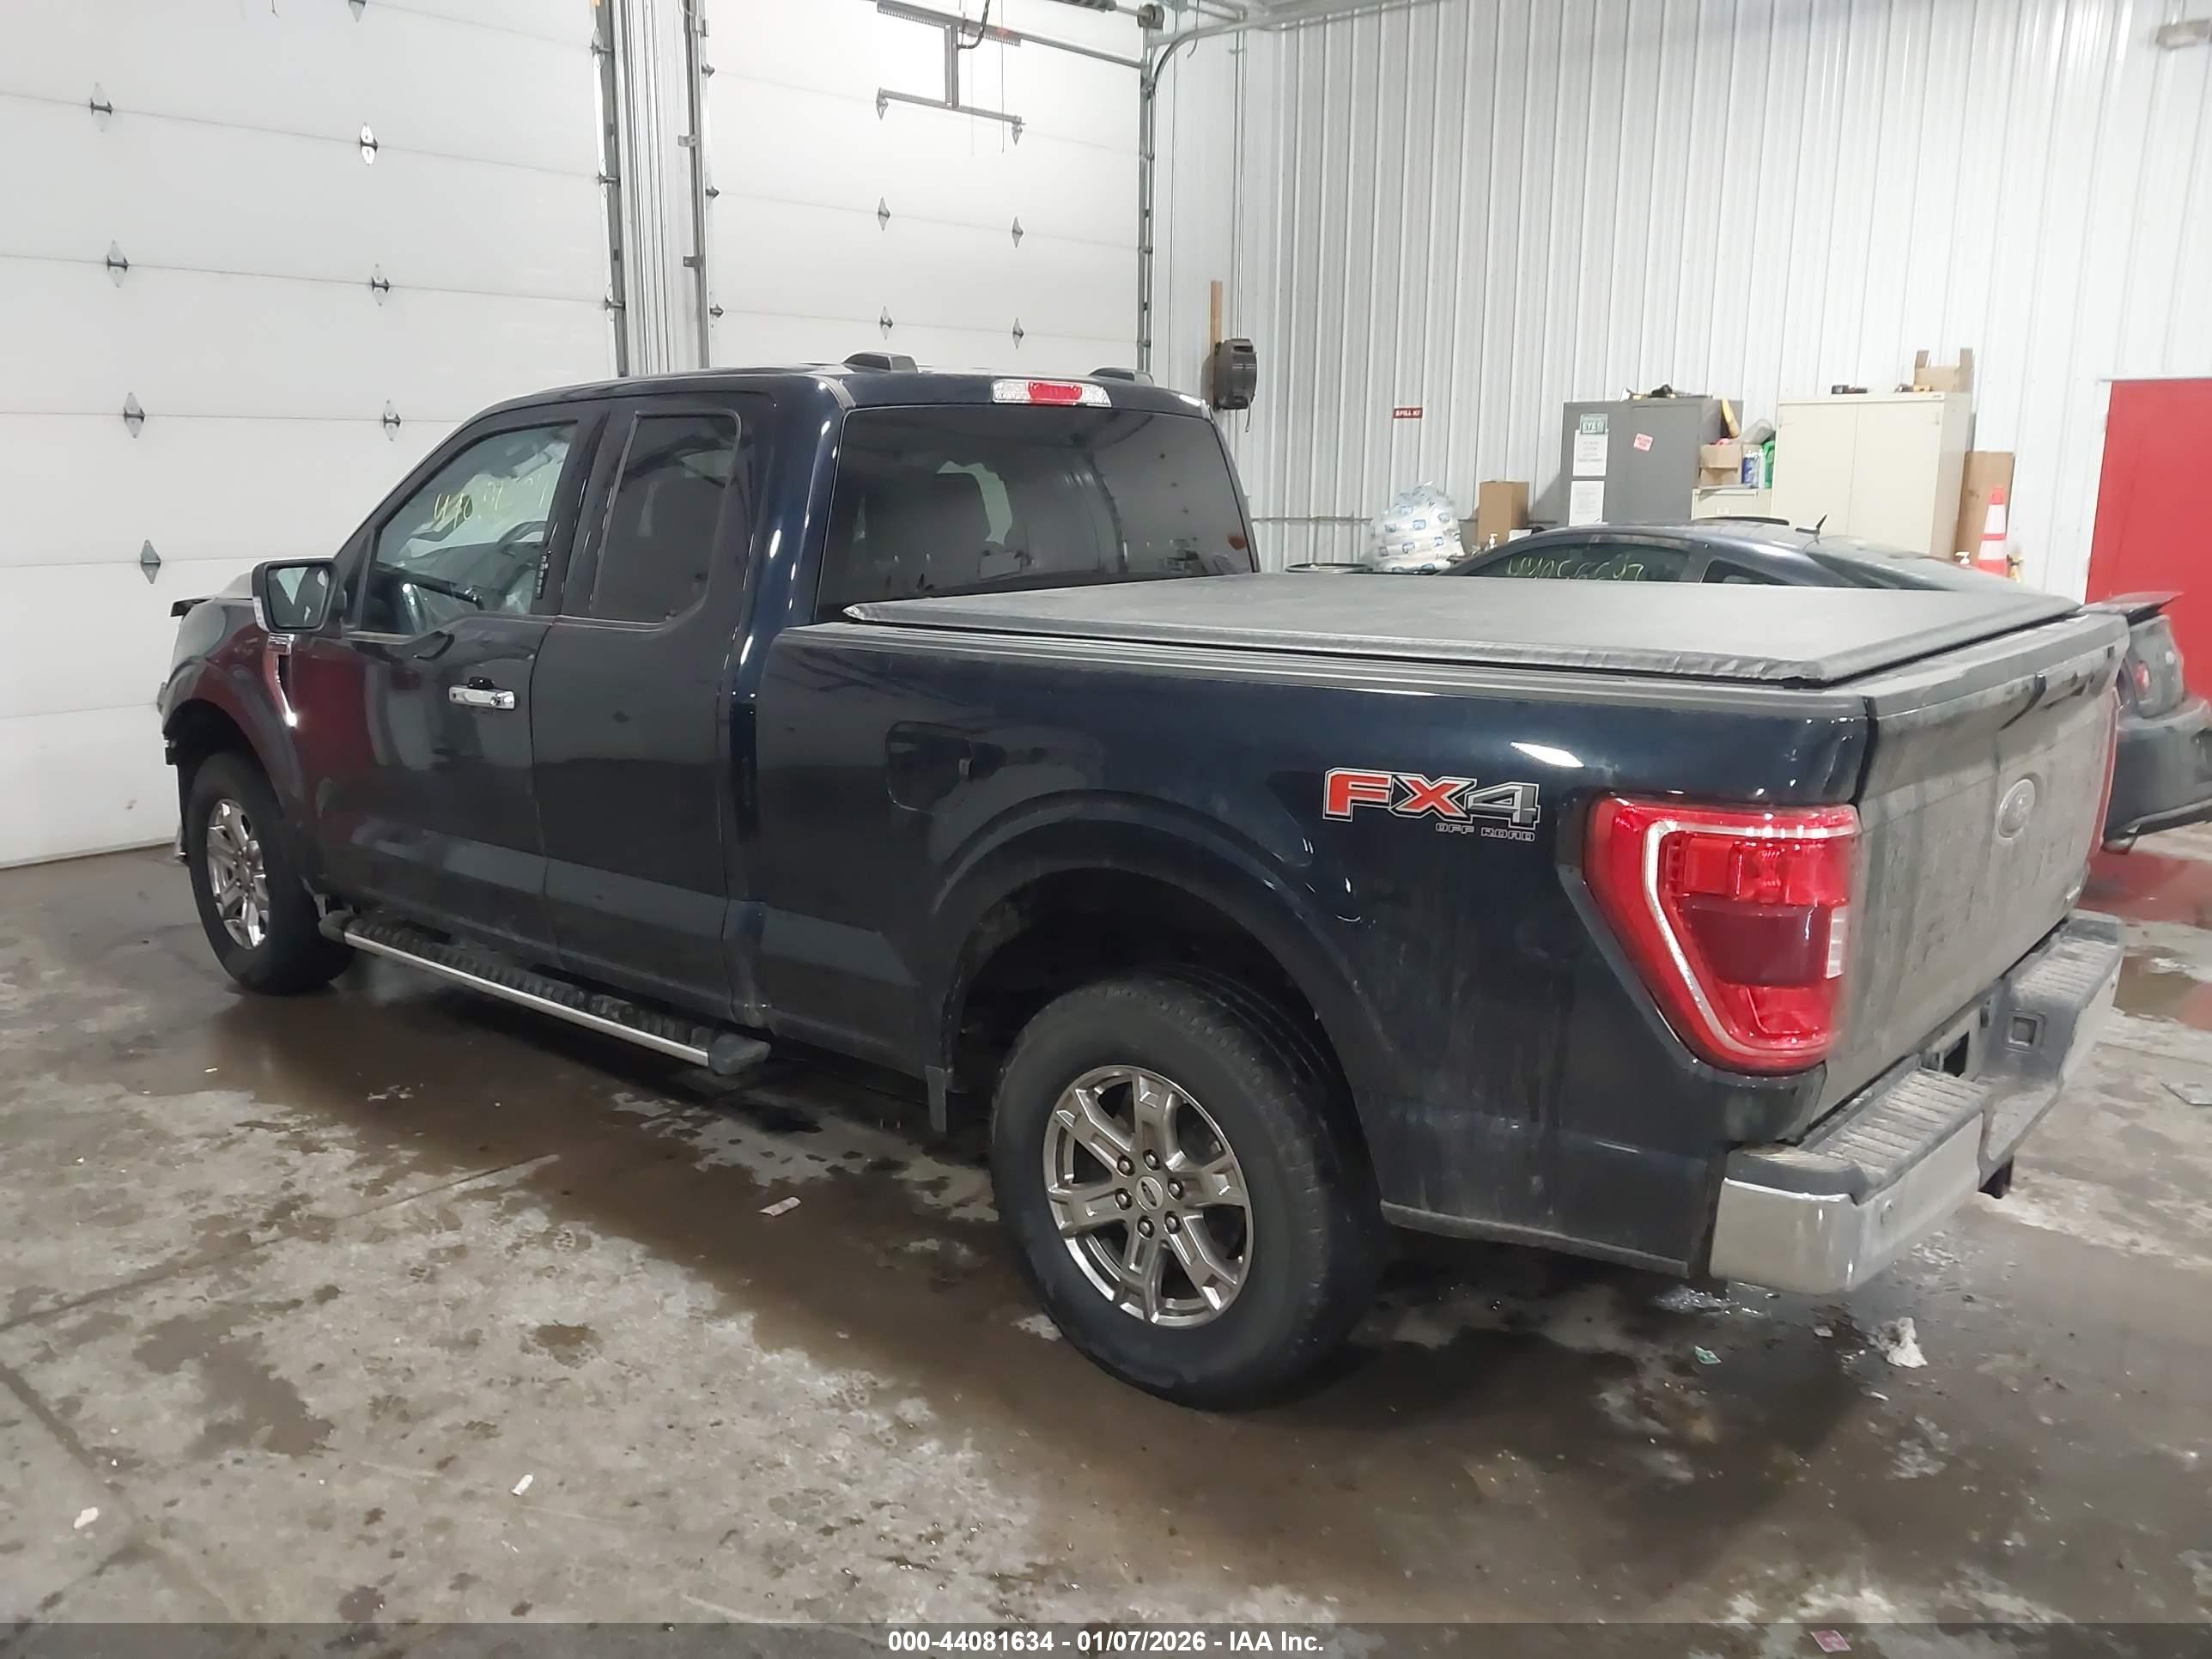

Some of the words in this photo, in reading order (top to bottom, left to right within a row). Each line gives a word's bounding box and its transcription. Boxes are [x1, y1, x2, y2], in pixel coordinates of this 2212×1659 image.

[1323, 767, 1541, 830] FX4
[1435, 822, 1475, 835] OFF
[1480, 827, 1536, 842] ROAD
